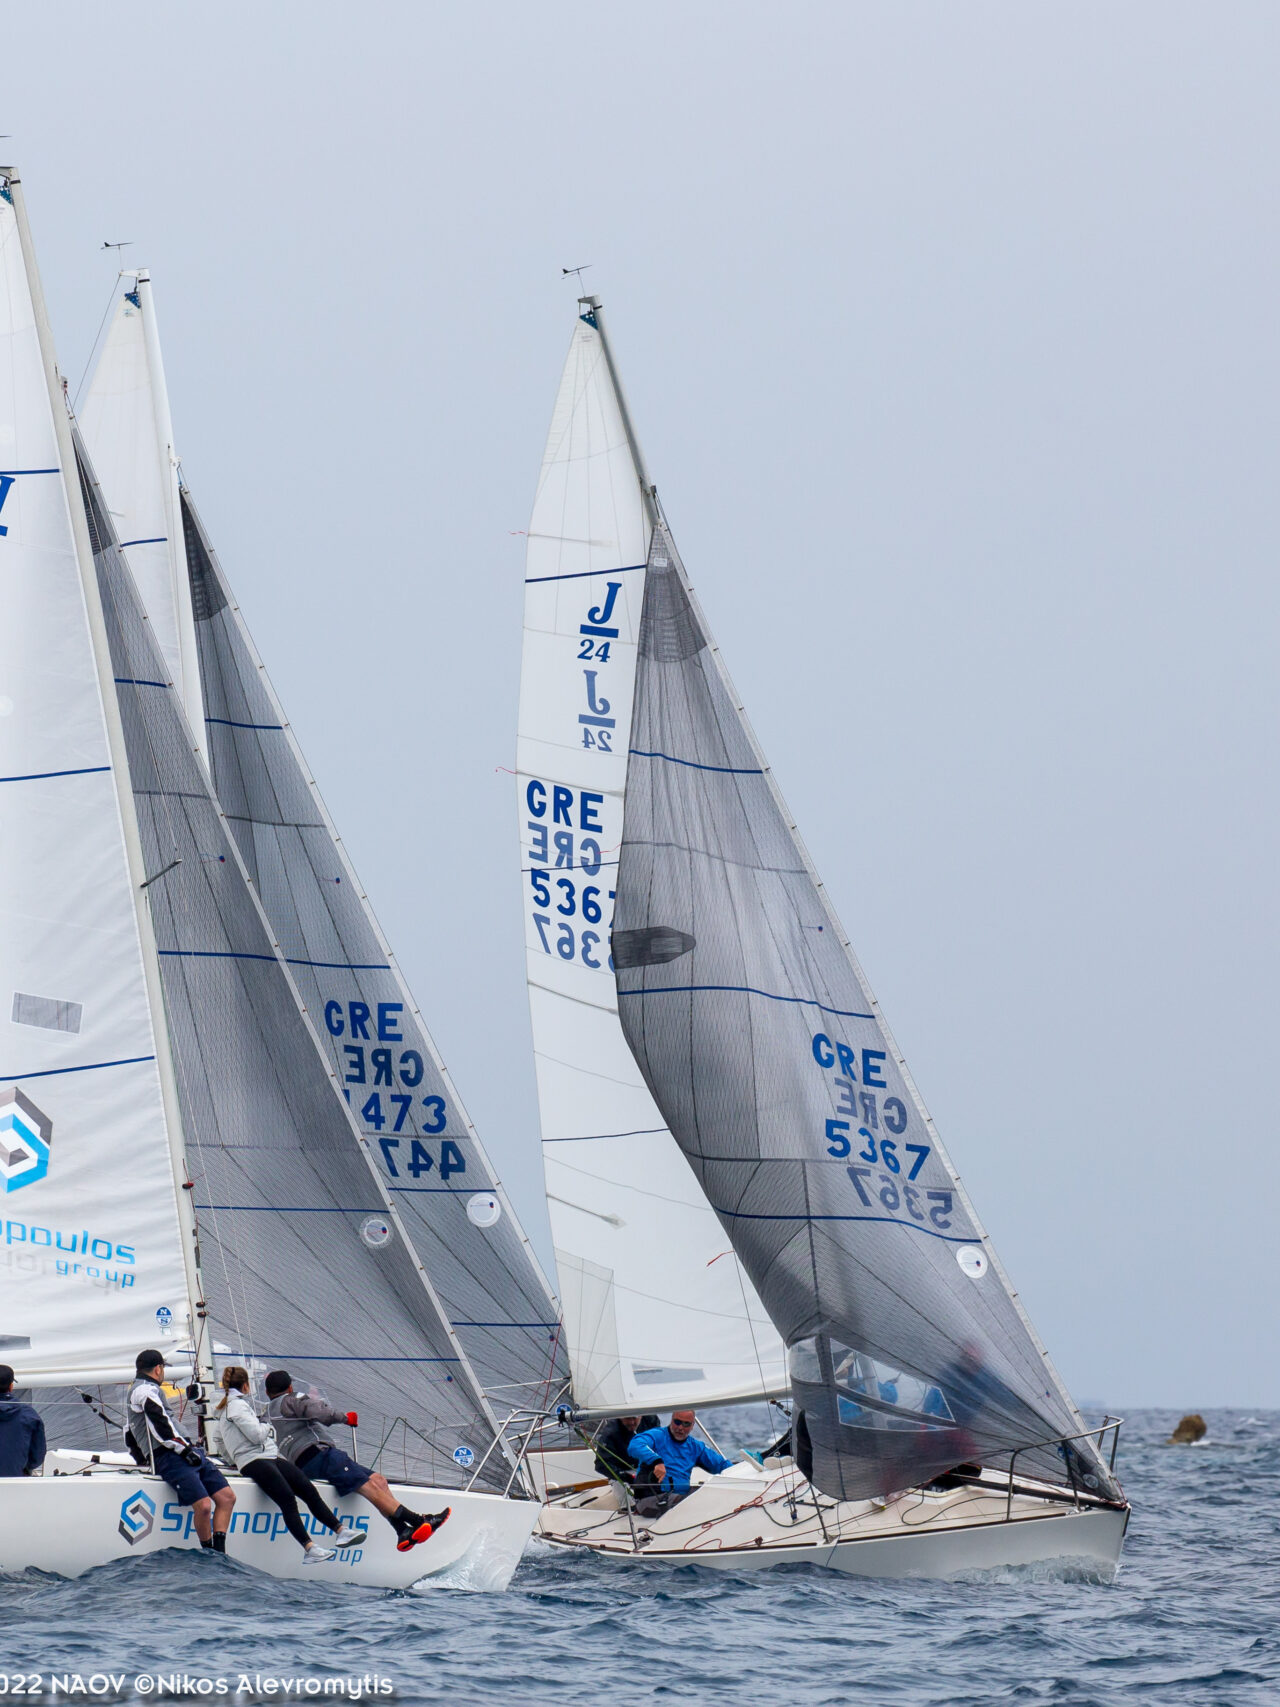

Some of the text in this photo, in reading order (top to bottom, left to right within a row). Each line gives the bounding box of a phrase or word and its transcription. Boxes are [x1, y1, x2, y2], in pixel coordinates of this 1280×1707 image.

[587, 582, 622, 625] J
[577, 639, 611, 663] 24
[526, 780, 604, 833] GRE
[529, 868, 616, 928] 536
[324, 1000, 403, 1042] GRE
[812, 1032, 887, 1089] GRE
[341, 1089, 447, 1134] 473
[825, 1118, 931, 1181] 5367
[56, 1259, 136, 1289] group
